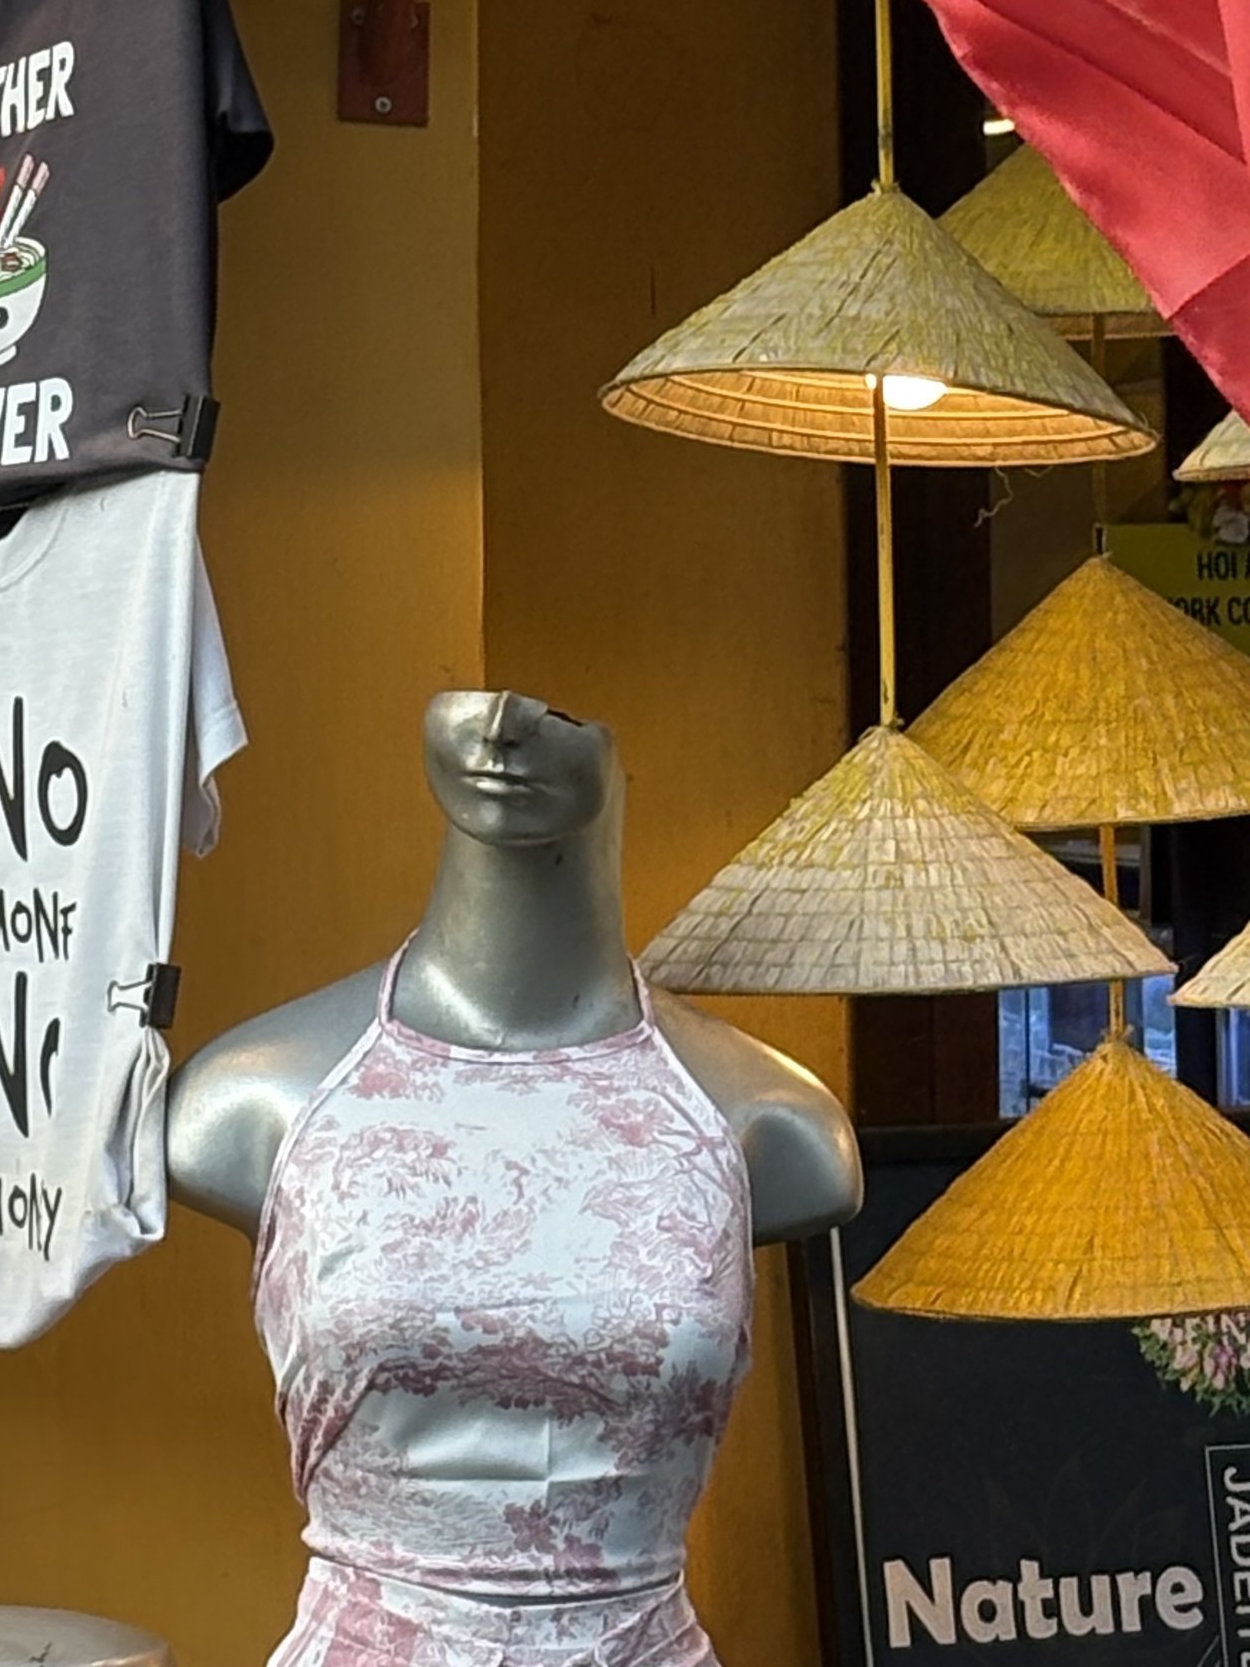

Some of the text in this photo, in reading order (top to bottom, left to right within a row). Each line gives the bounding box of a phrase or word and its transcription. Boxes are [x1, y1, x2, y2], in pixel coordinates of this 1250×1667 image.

[1197, 551, 1238, 580] HOI
[1167, 596, 1223, 627] RK
[883, 1556, 1204, 1650] Nature
